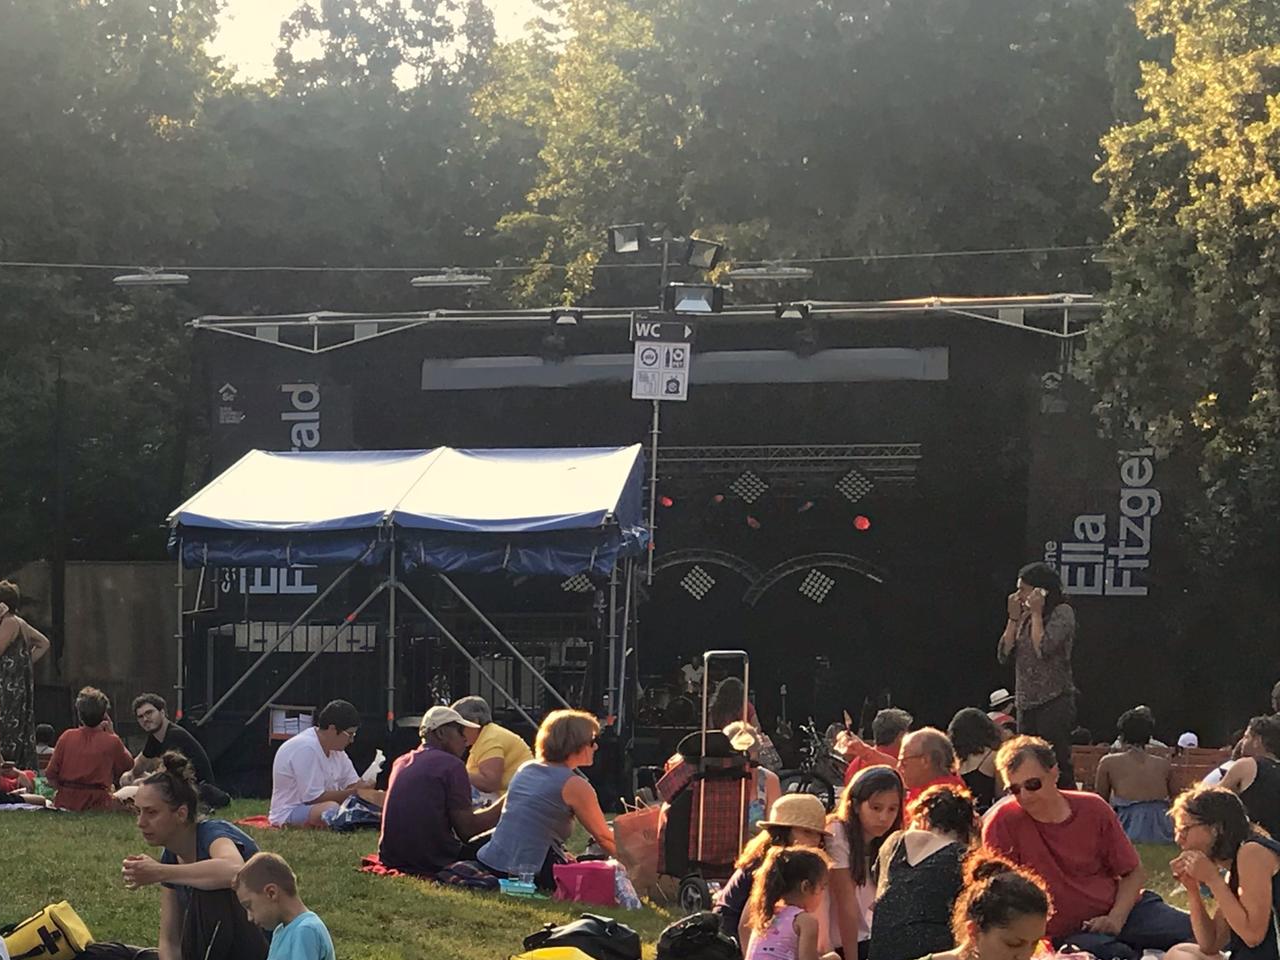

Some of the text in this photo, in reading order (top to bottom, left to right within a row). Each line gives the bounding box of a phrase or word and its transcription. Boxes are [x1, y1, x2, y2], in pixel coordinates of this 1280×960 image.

[635, 323, 660, 338] WC
[281, 383, 320, 452] ald
[1061, 513, 1106, 596] Ella
